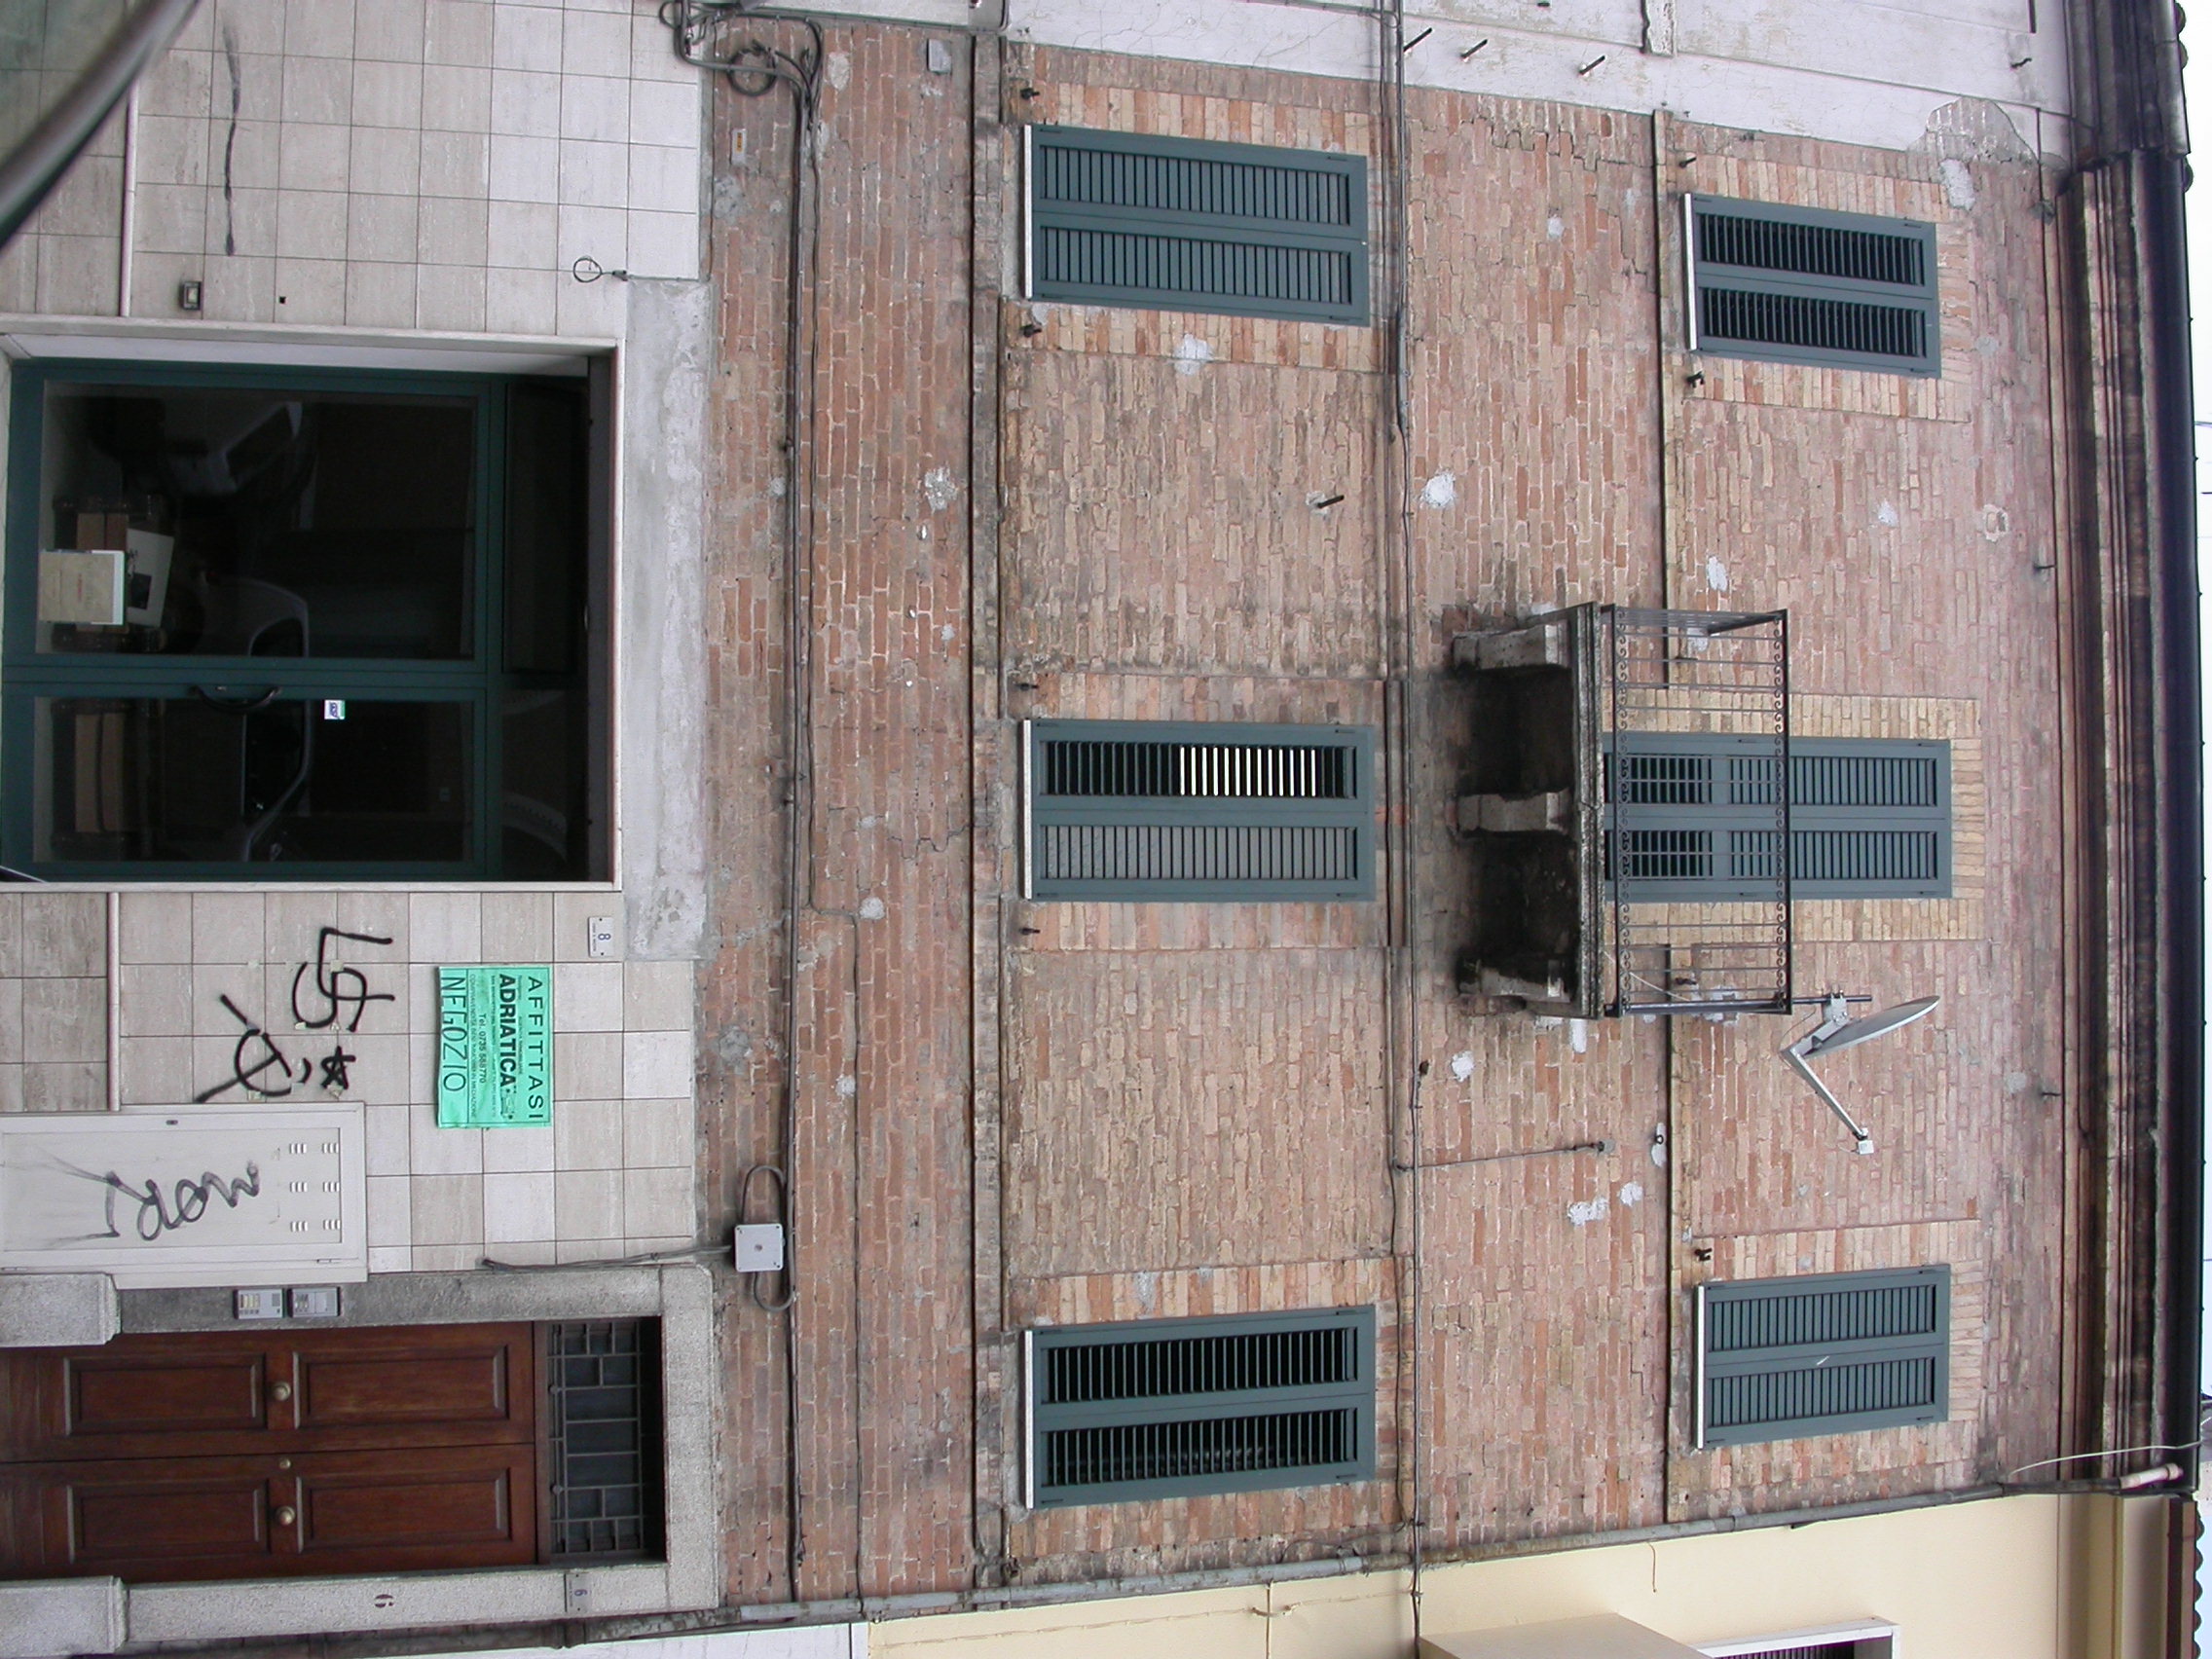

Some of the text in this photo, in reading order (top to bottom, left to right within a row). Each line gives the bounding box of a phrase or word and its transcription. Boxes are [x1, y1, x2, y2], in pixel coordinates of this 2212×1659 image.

[441, 977, 467, 1091] NEGOZIO
[499, 974, 516, 1087] ADRIATICA
[529, 977, 543, 1118] AFFITTASI
[375, 1594, 394, 1608] 6
